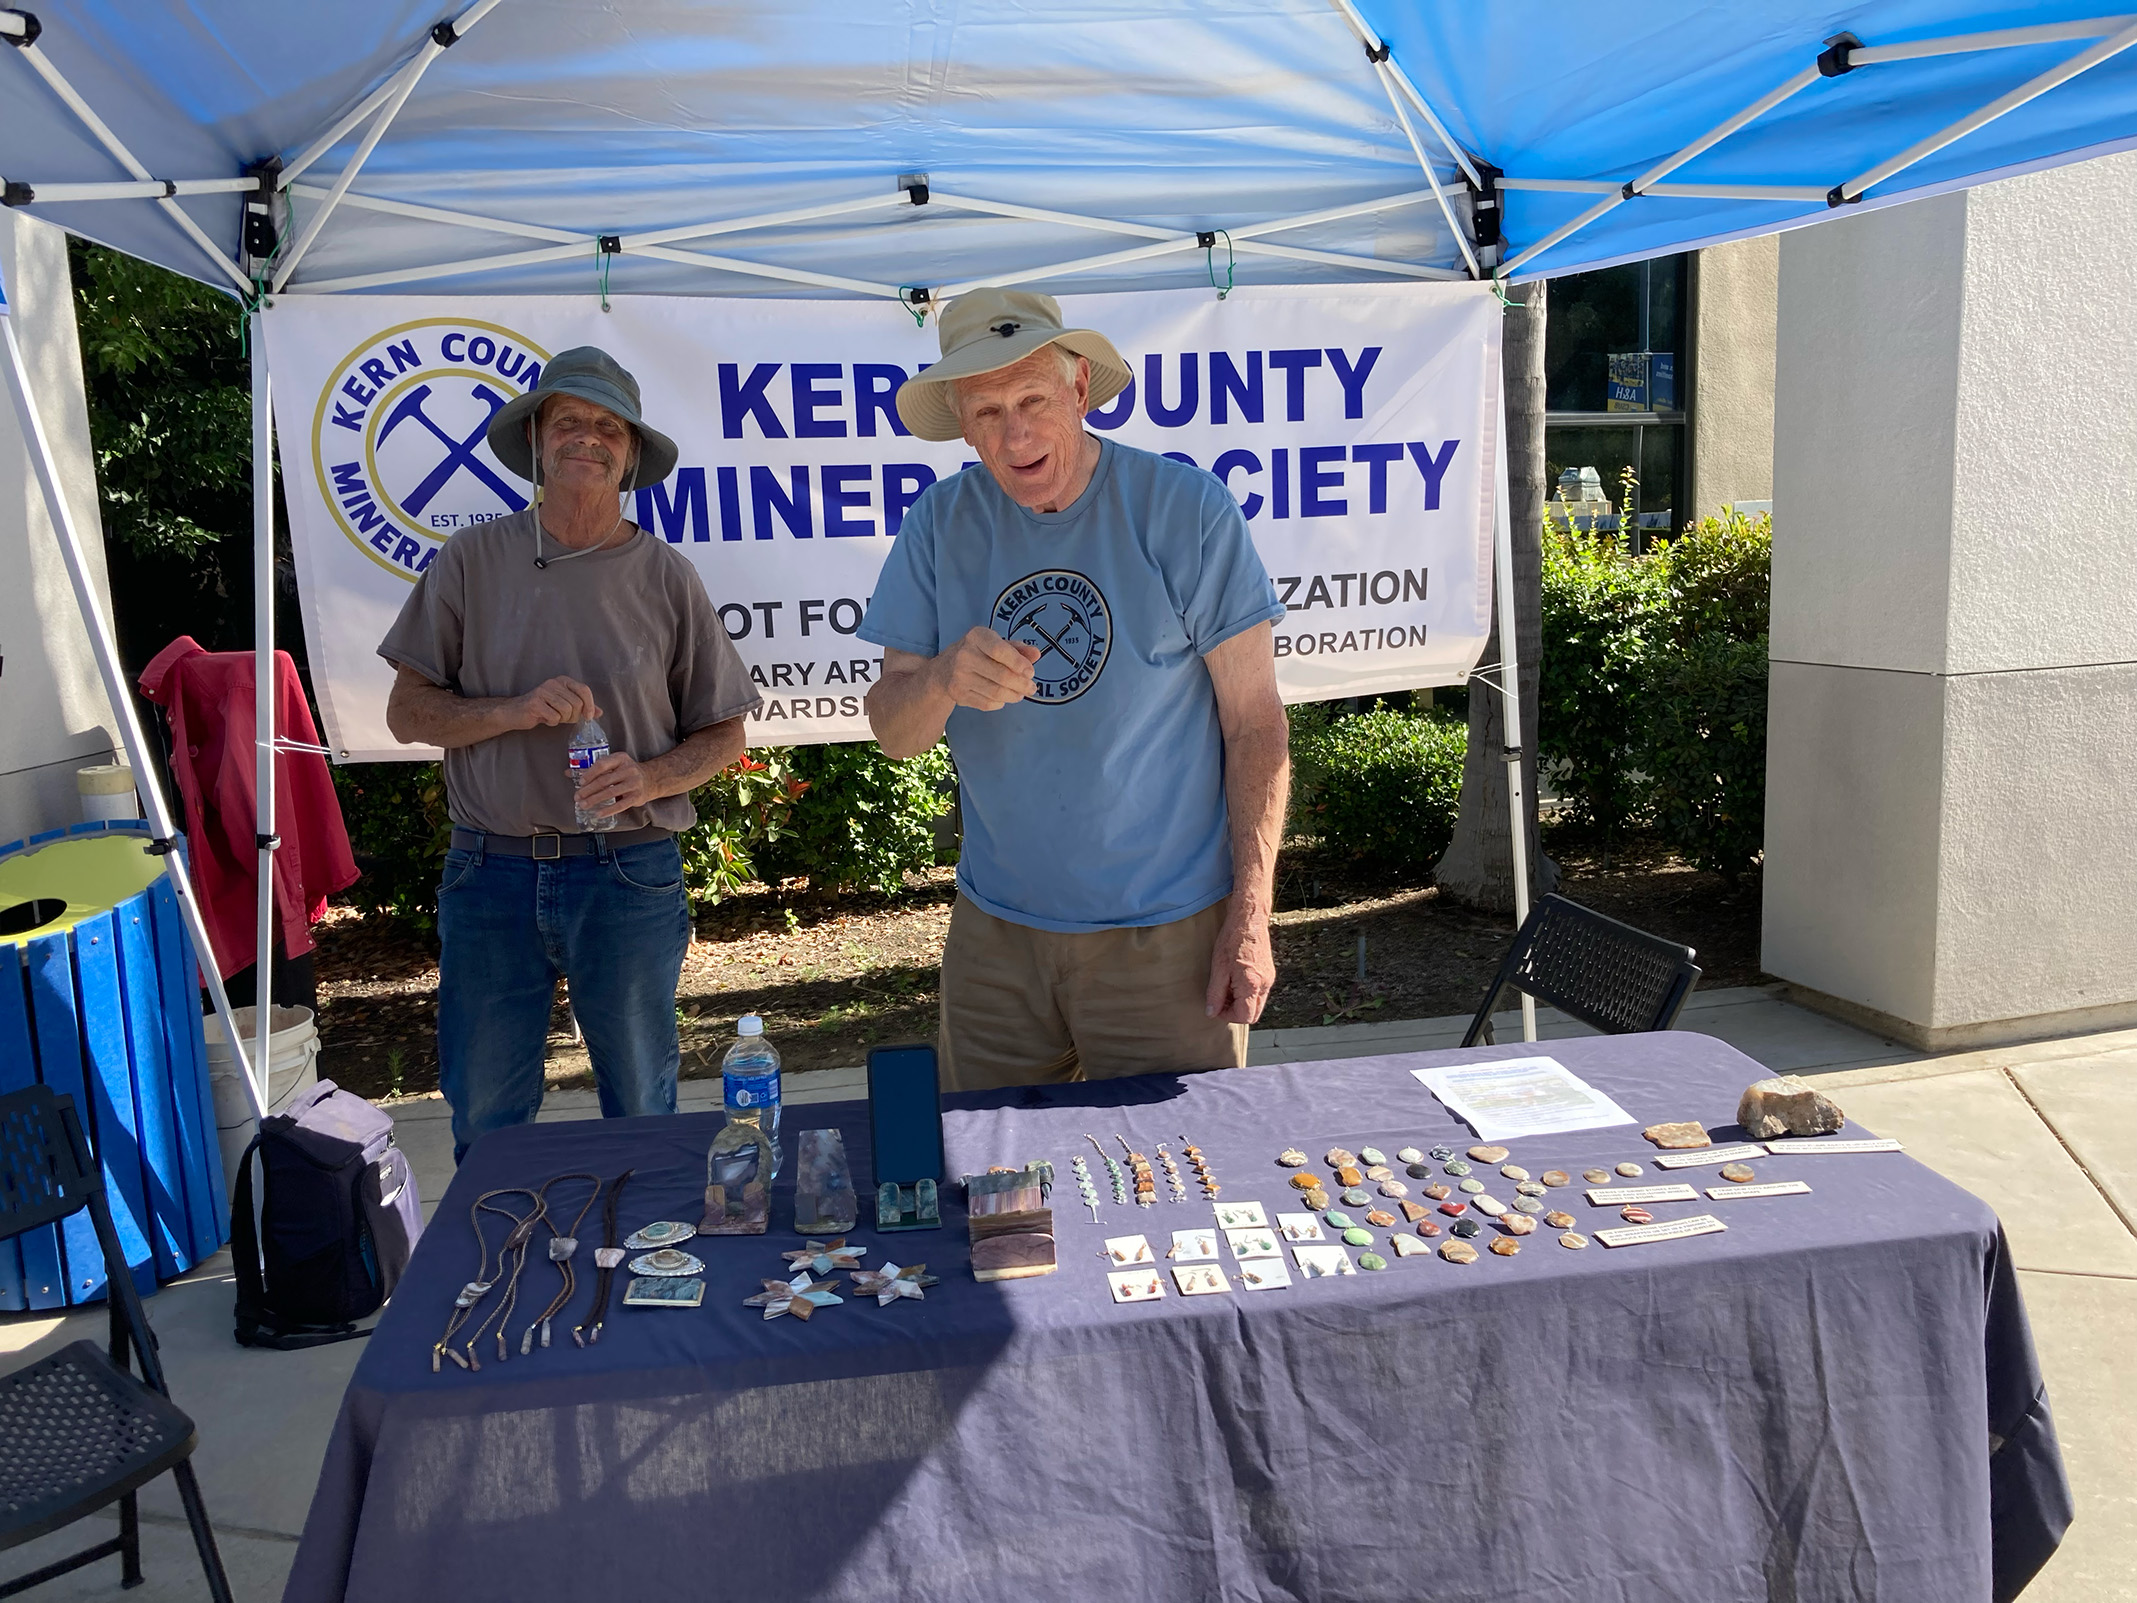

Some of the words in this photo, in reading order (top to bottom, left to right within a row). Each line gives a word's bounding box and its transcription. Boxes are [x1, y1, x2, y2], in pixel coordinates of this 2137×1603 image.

[331, 339, 422, 432] KERN
[441, 333, 542, 392] COUN
[717, 363, 936, 439] KER
[1083, 347, 1383, 431] OUNTY
[330, 461, 438, 572] MINER
[431, 514, 464, 527] EST.
[635, 461, 982, 543] MINER
[1161, 440, 1461, 521] CIETY
[717, 601, 782, 640] OT
[799, 598, 871, 636] FO
[1270, 568, 1428, 611] ZATION
[997, 581, 1040, 622] KERN
[1043, 577, 1103, 618] COUNTY
[750, 662, 816, 687] ARY
[824, 658, 885, 685] AR
[1274, 625, 1427, 657] BORATION
[1059, 634, 1104, 697] SOCIETY
[1065, 637, 1080, 645] 1935
[741, 696, 869, 721] ARDS
